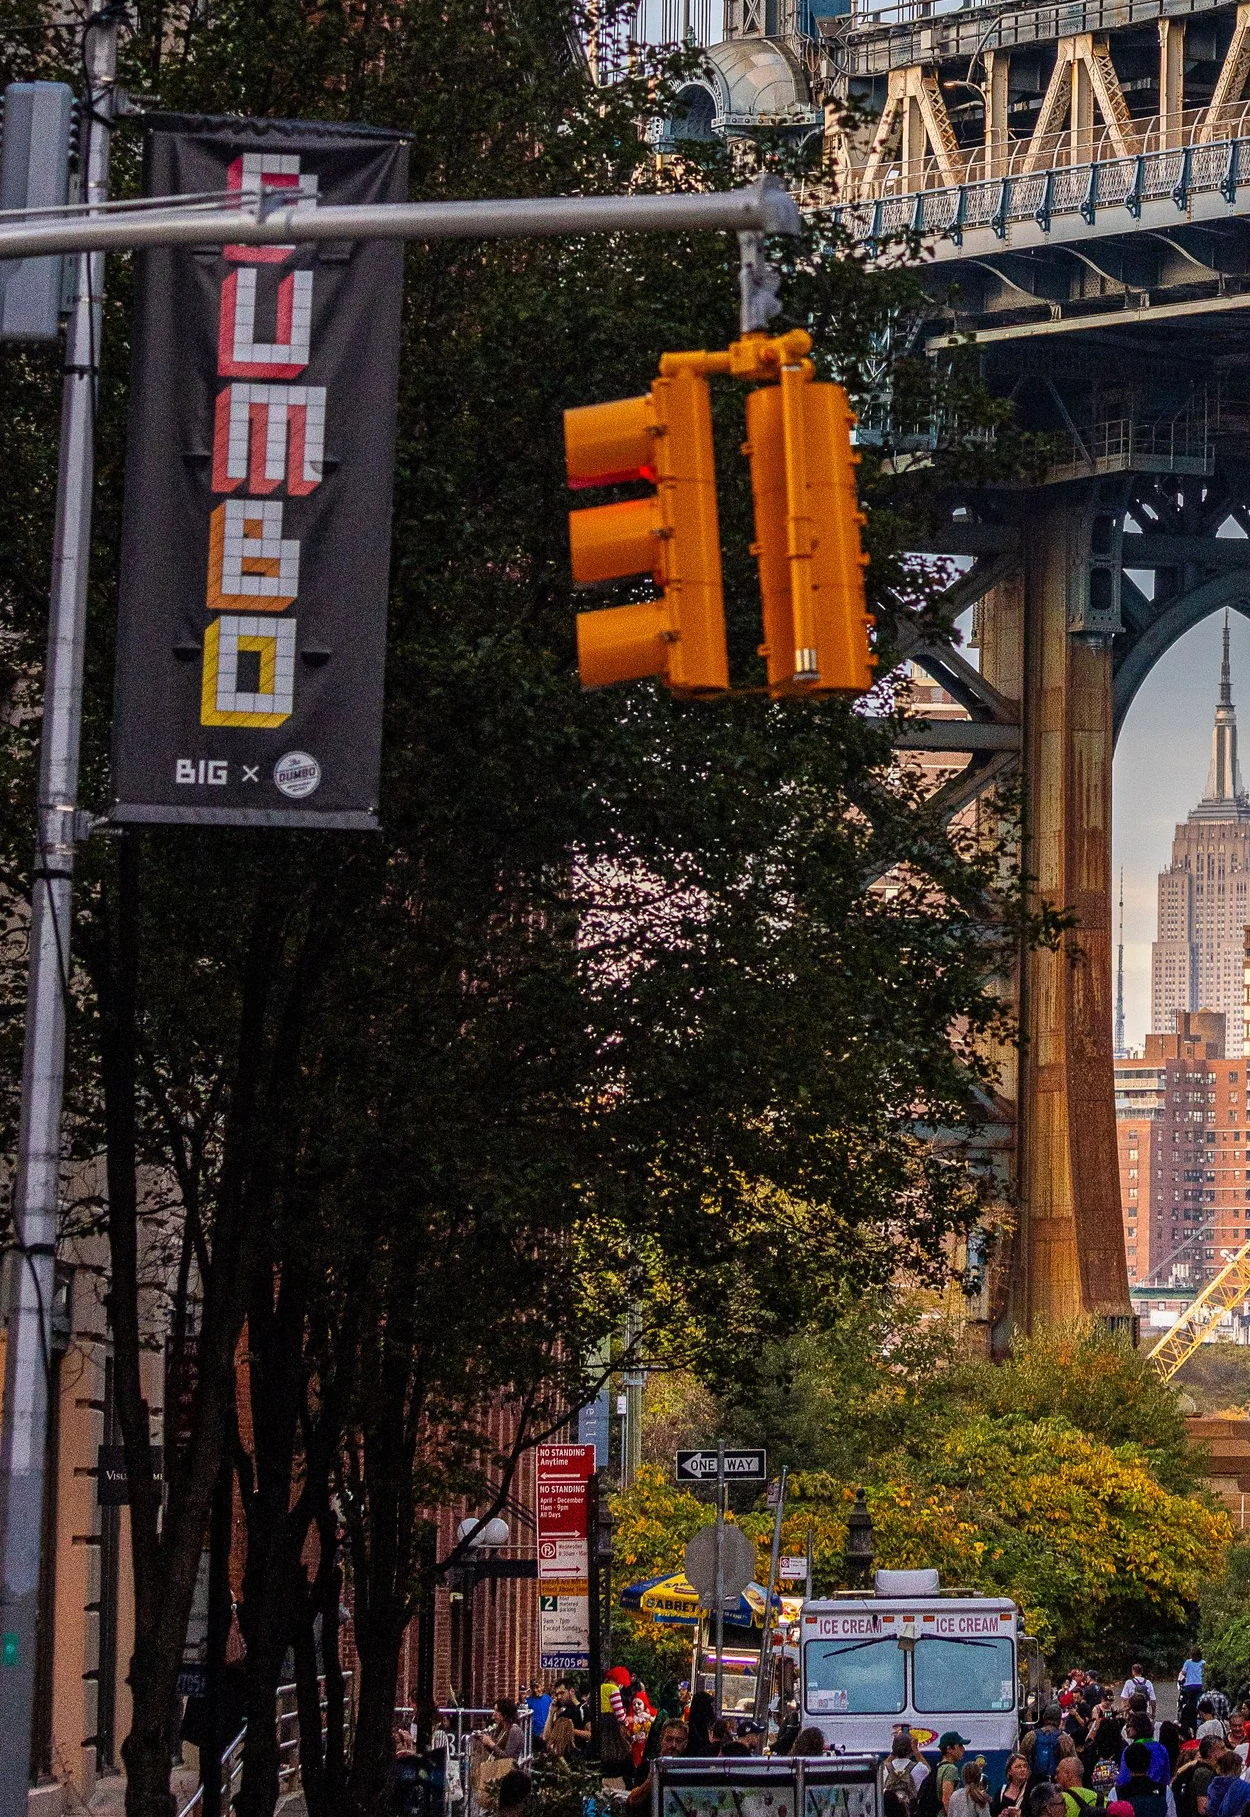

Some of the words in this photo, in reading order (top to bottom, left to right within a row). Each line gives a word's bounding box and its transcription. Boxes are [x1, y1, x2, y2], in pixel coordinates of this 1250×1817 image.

[175, 759, 228, 785] BIG
[278, 766, 316, 783] DUMBO
[539, 1448, 550, 1457] NO
[551, 1448, 586, 1457] STANDING
[540, 1457, 569, 1467] Anytime
[690, 1459, 715, 1471] ONE
[727, 1459, 754, 1470] WAY
[539, 1485, 550, 1494] NO
[551, 1485, 586, 1493] STANDING
[540, 1497, 553, 1505] April
[548, 1511, 561, 1519] Days
[544, 1596, 554, 1610] 2
[819, 1619, 838, 1634] ICE
[842, 1619, 882, 1634] CREAM
[936, 1618, 955, 1633] ICE
[958, 1617, 999, 1632] CREAM
[542, 1657, 576, 1668] 342705
